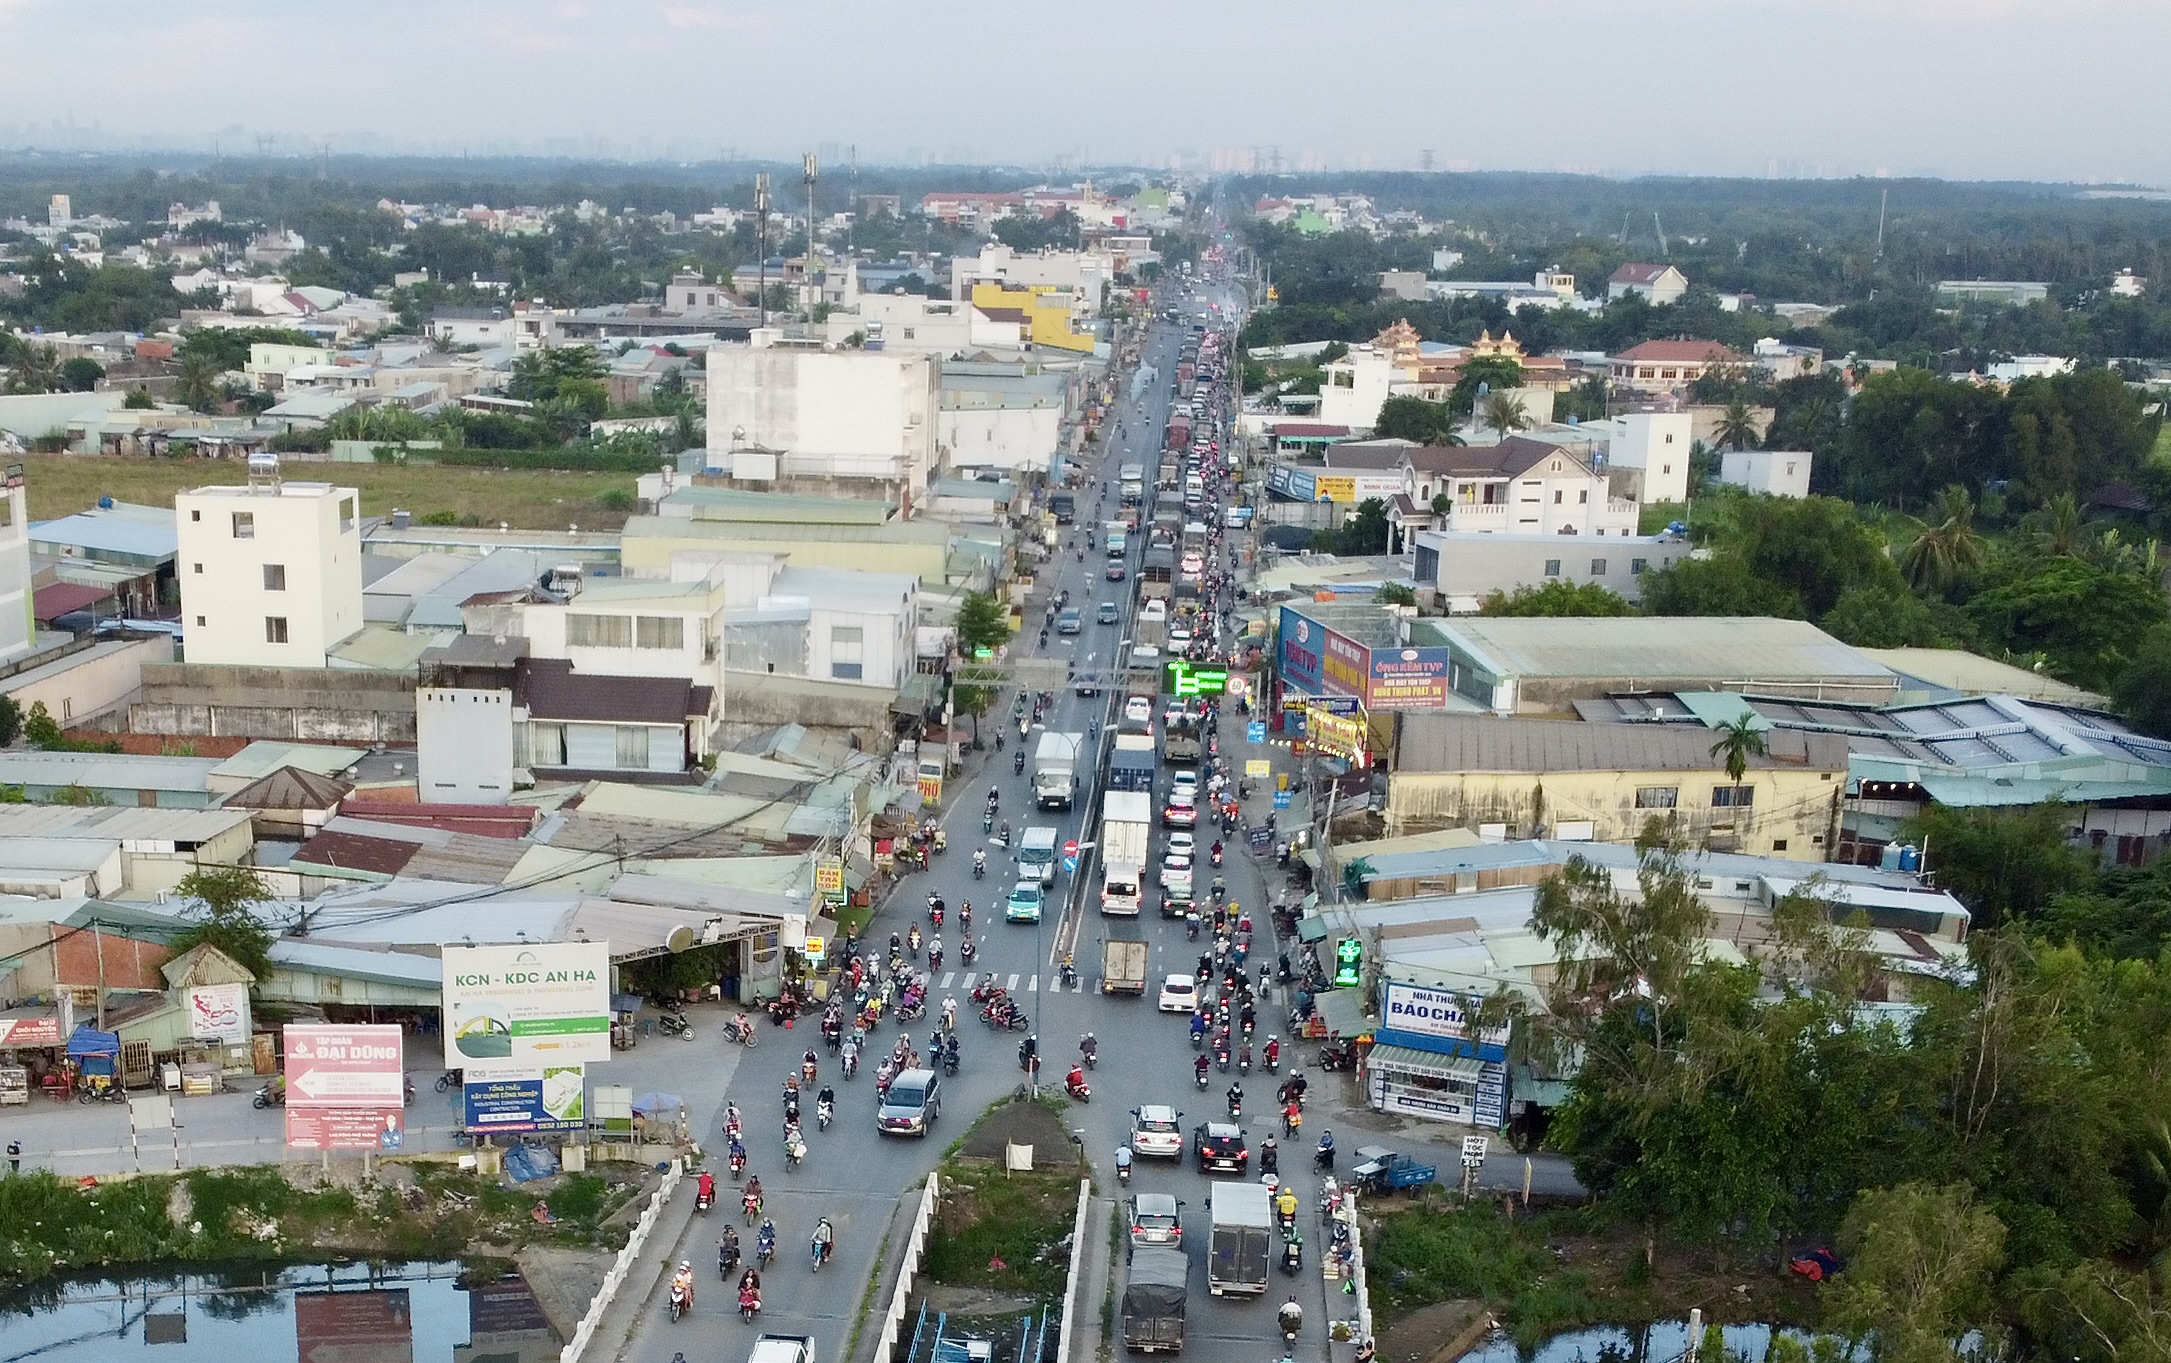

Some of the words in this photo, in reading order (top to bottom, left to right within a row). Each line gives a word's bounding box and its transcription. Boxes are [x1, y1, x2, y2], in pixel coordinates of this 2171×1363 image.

[456, 974, 489, 987] KCN
[505, 972, 539, 984] KDC
[546, 971, 567, 982] AN
[574, 970, 596, 984] HẠ
[316, 1046, 345, 1060] ĐẠI
[350, 1045, 397, 1059] DŨNG
